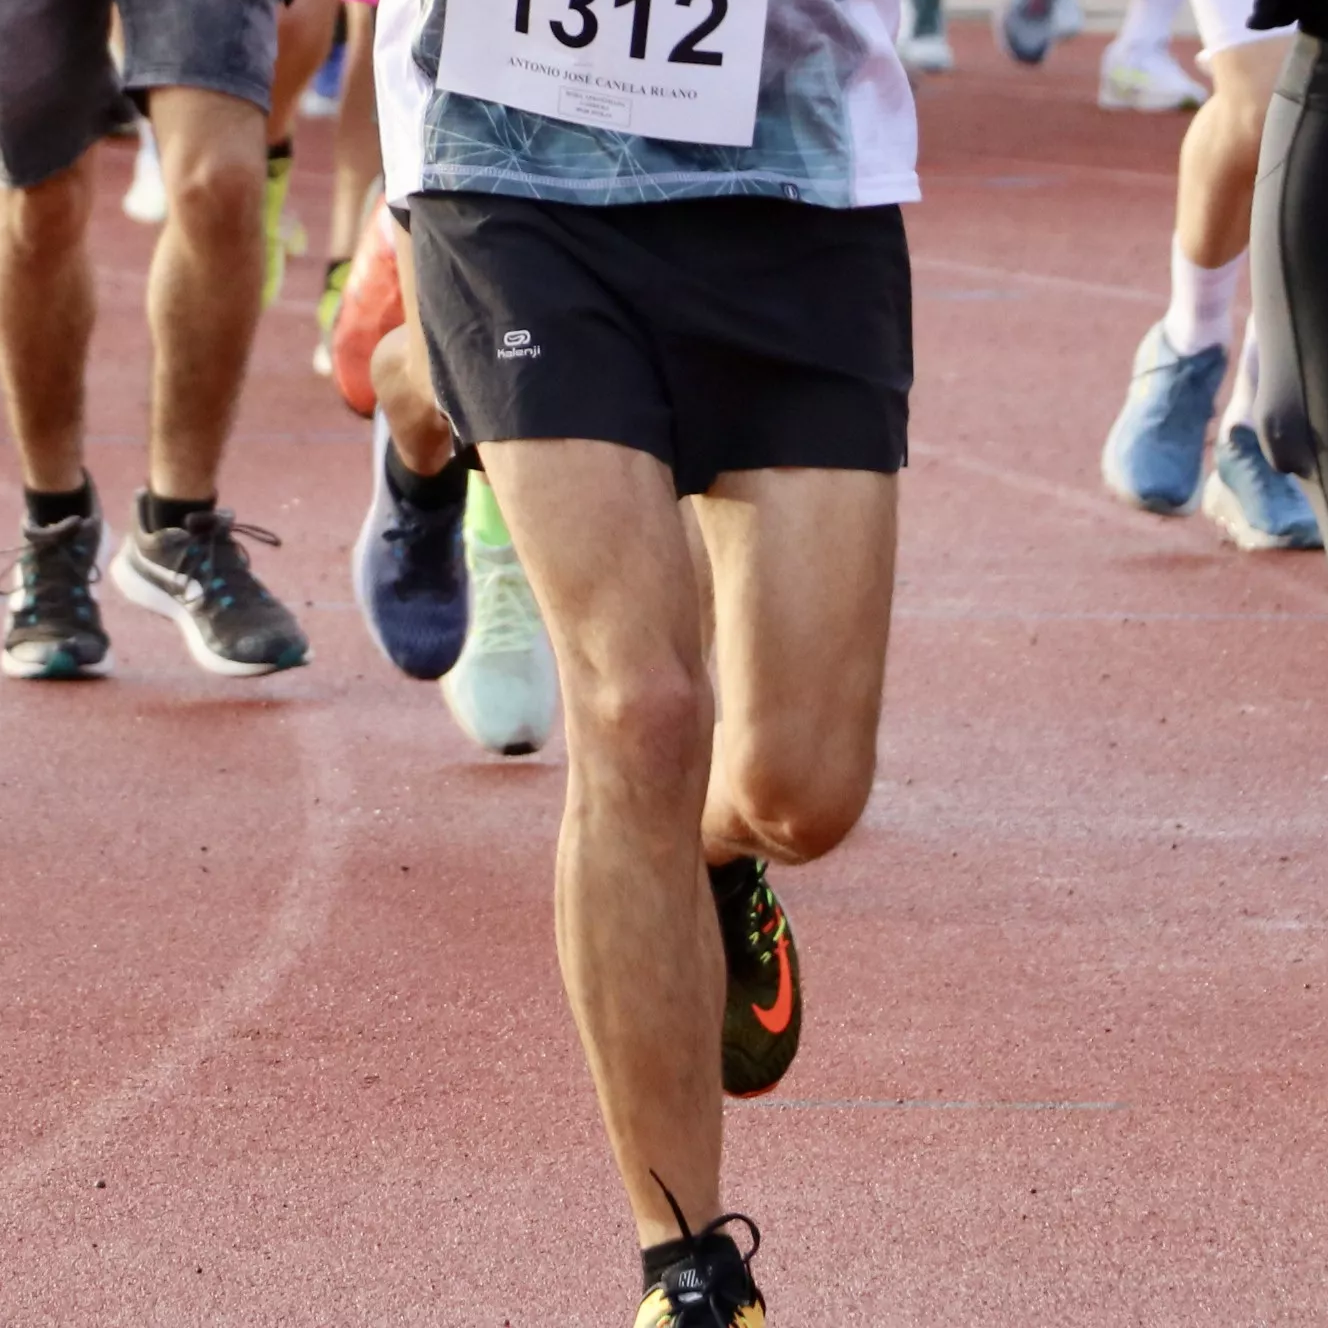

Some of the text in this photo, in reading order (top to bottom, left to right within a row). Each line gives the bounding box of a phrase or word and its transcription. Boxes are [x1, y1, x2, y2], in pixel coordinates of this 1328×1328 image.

[507, 56, 698, 100] ANTONIO JOSÉ CANELA RUANO
[496, 345, 541, 359] Kalenji
